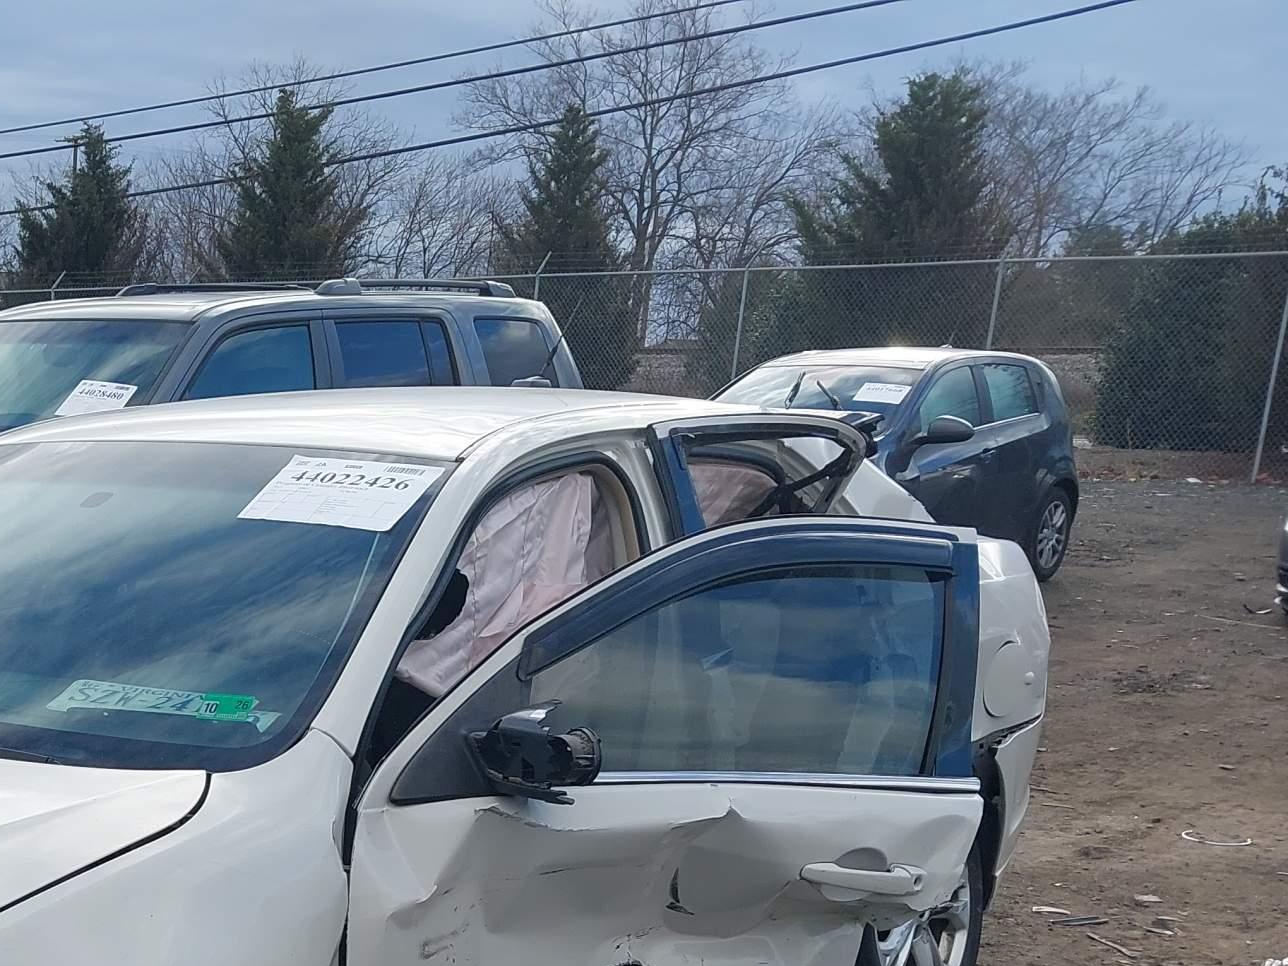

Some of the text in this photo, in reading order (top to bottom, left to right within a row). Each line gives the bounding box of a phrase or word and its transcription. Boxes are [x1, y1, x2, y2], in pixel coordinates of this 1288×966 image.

[78, 388, 125, 401] 44028480
[290, 469, 415, 491] 44022426
[204, 702, 219, 714] 10
[235, 700, 249, 710] 26
